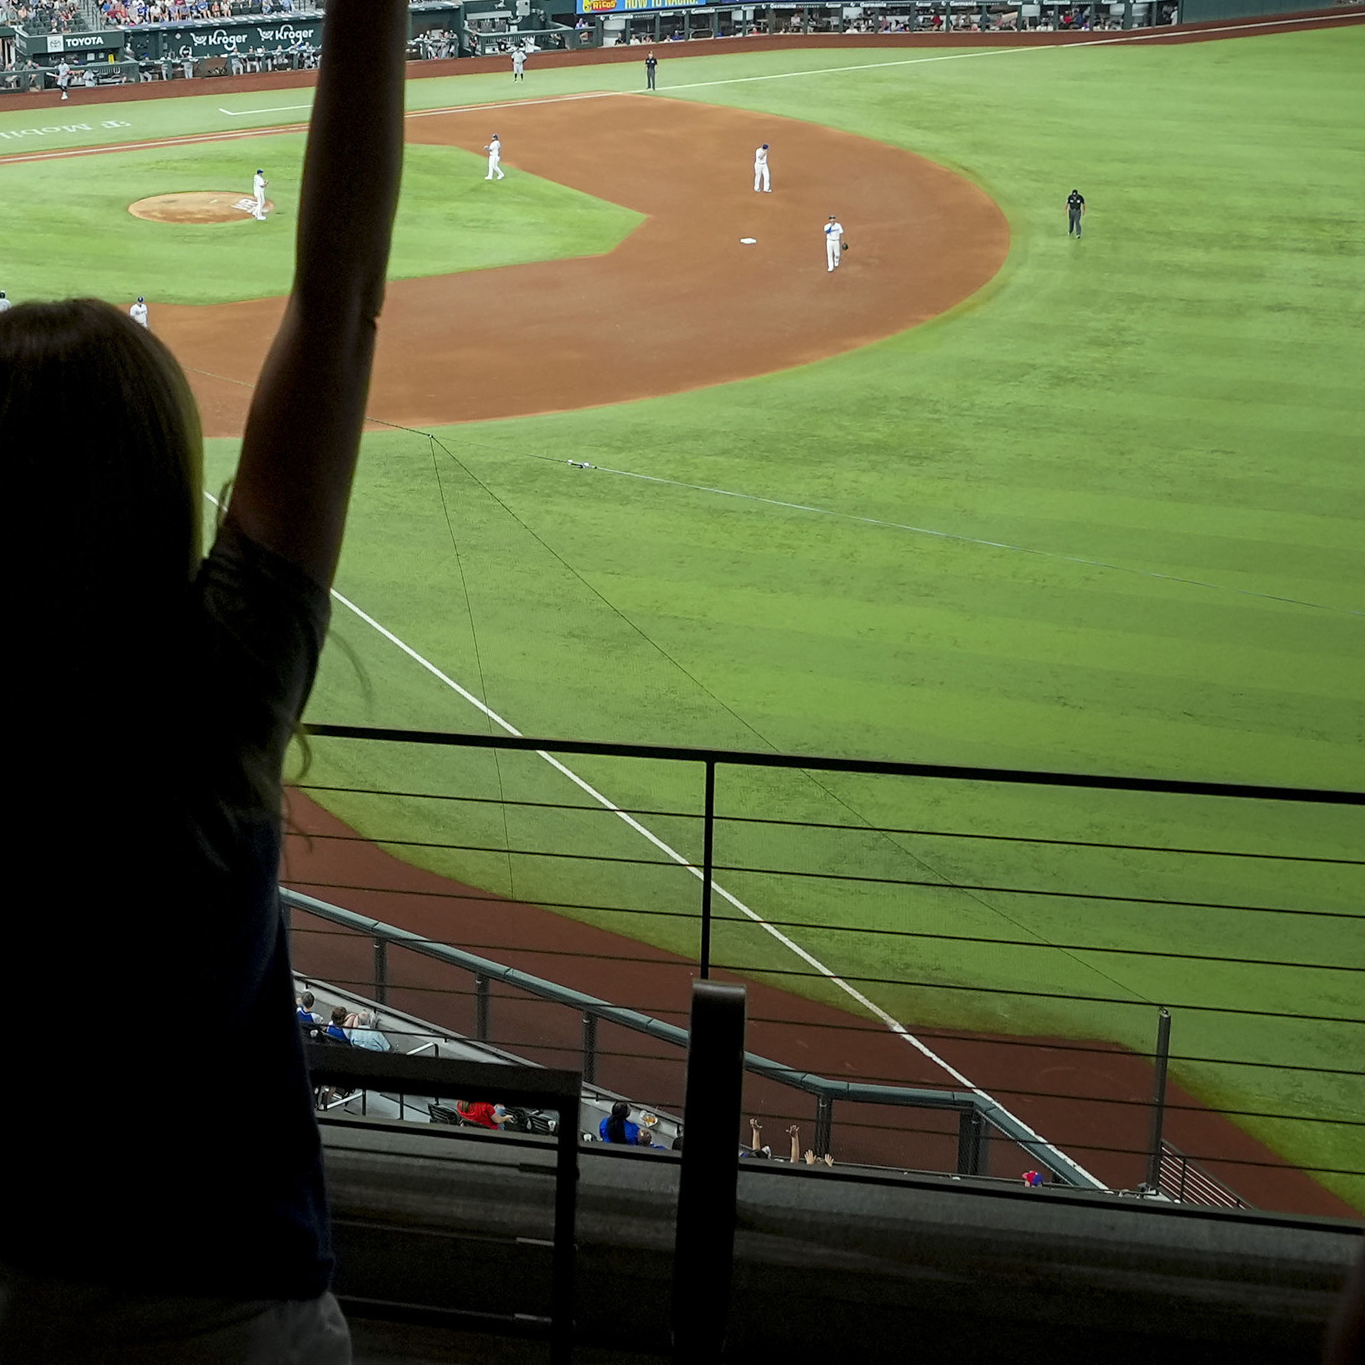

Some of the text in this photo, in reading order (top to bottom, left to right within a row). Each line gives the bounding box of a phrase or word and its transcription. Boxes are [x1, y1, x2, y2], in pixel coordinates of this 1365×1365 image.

[66, 37, 103, 47] TOYOTA
[209, 30, 248, 50] Kroger
[275, 25, 315, 45] Kroger
